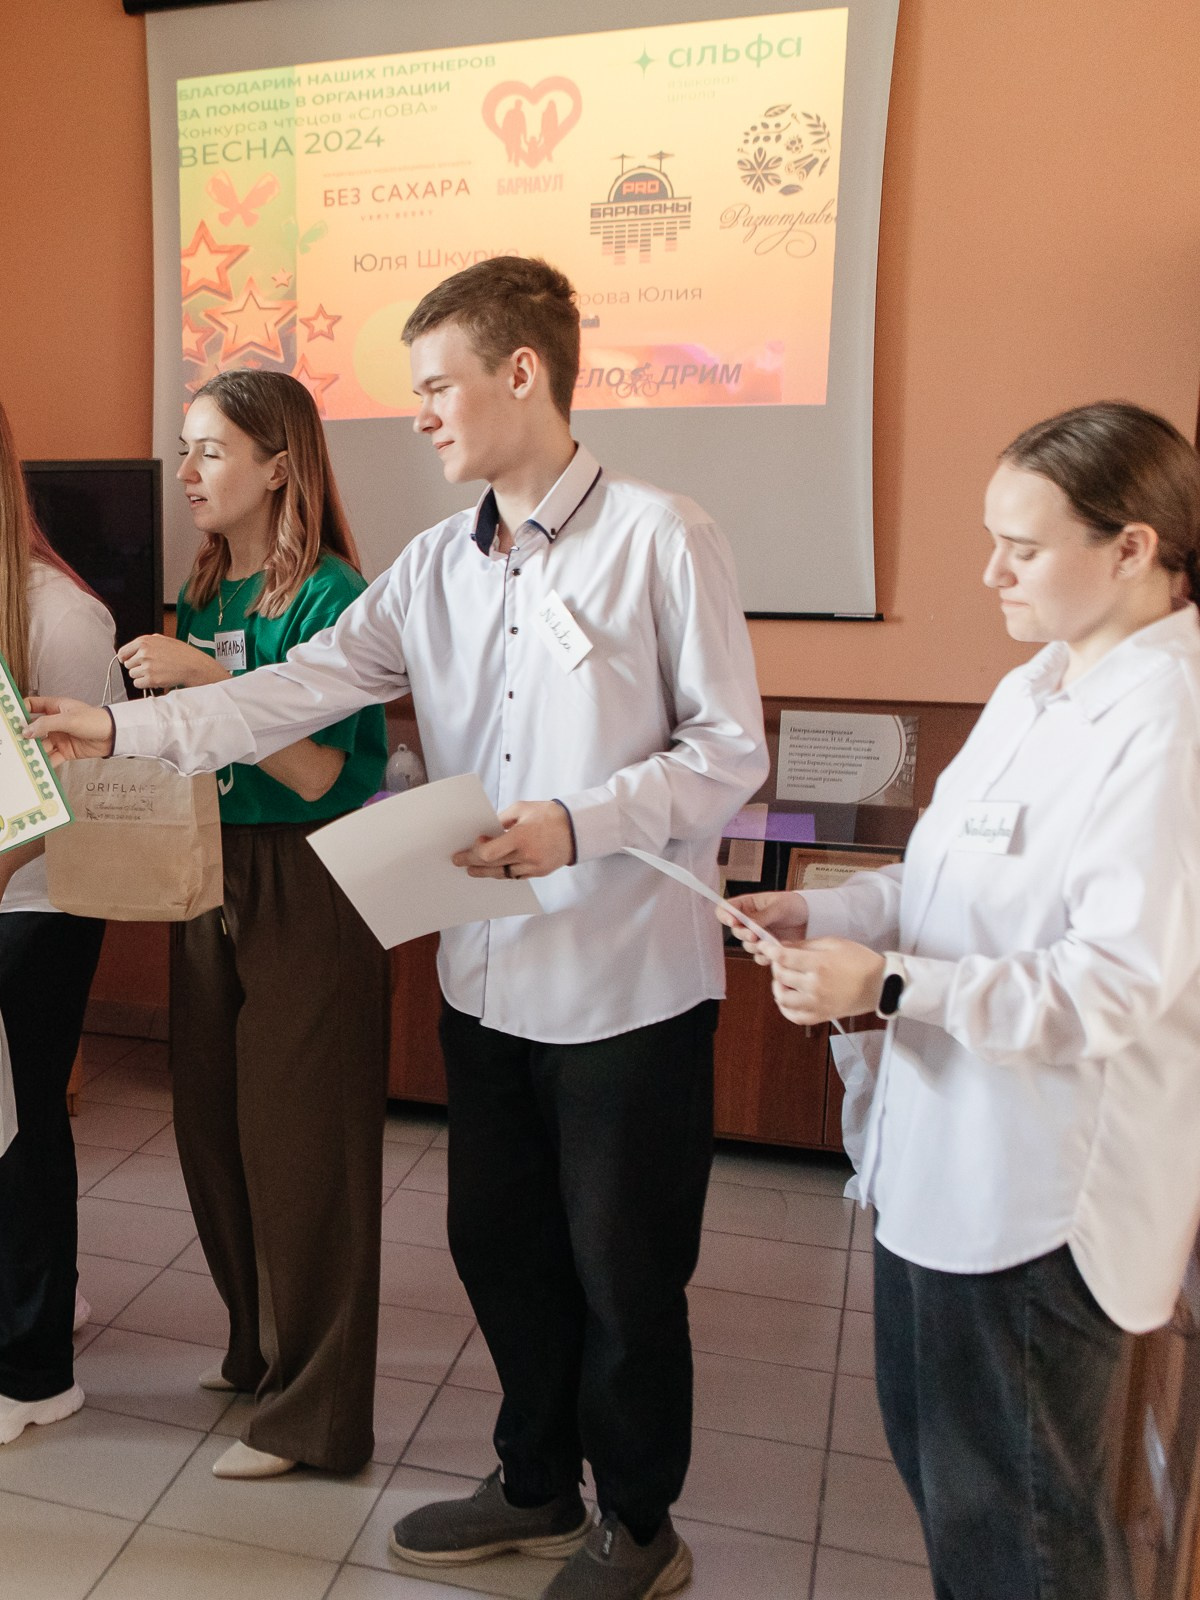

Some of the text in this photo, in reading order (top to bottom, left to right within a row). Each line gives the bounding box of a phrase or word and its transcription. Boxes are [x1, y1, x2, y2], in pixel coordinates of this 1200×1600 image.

[179, 55, 496, 100] БЛАГОДАРИМ НАШИХ ПАРТНЕРОВ
[179, 80, 451, 122] ЗА ПОМОЩЬ В ОРГАНИЗАЦИИ
[179, 118, 268, 141] Конкурса
[274, 111, 342, 130] чтецов
[179, 126, 385, 169] ВЕСНА 2024
[323, 178, 471, 207] БЕЗ САХАРА
[497, 173, 564, 196] БАРНАУЛ
[622, 179, 660, 195] PRO
[589, 200, 692, 220] БАРАБАНЫ
[354, 253, 407, 273] Юля
[638, 286, 702, 303] Юлия
[658, 363, 743, 390] ДРИМ
